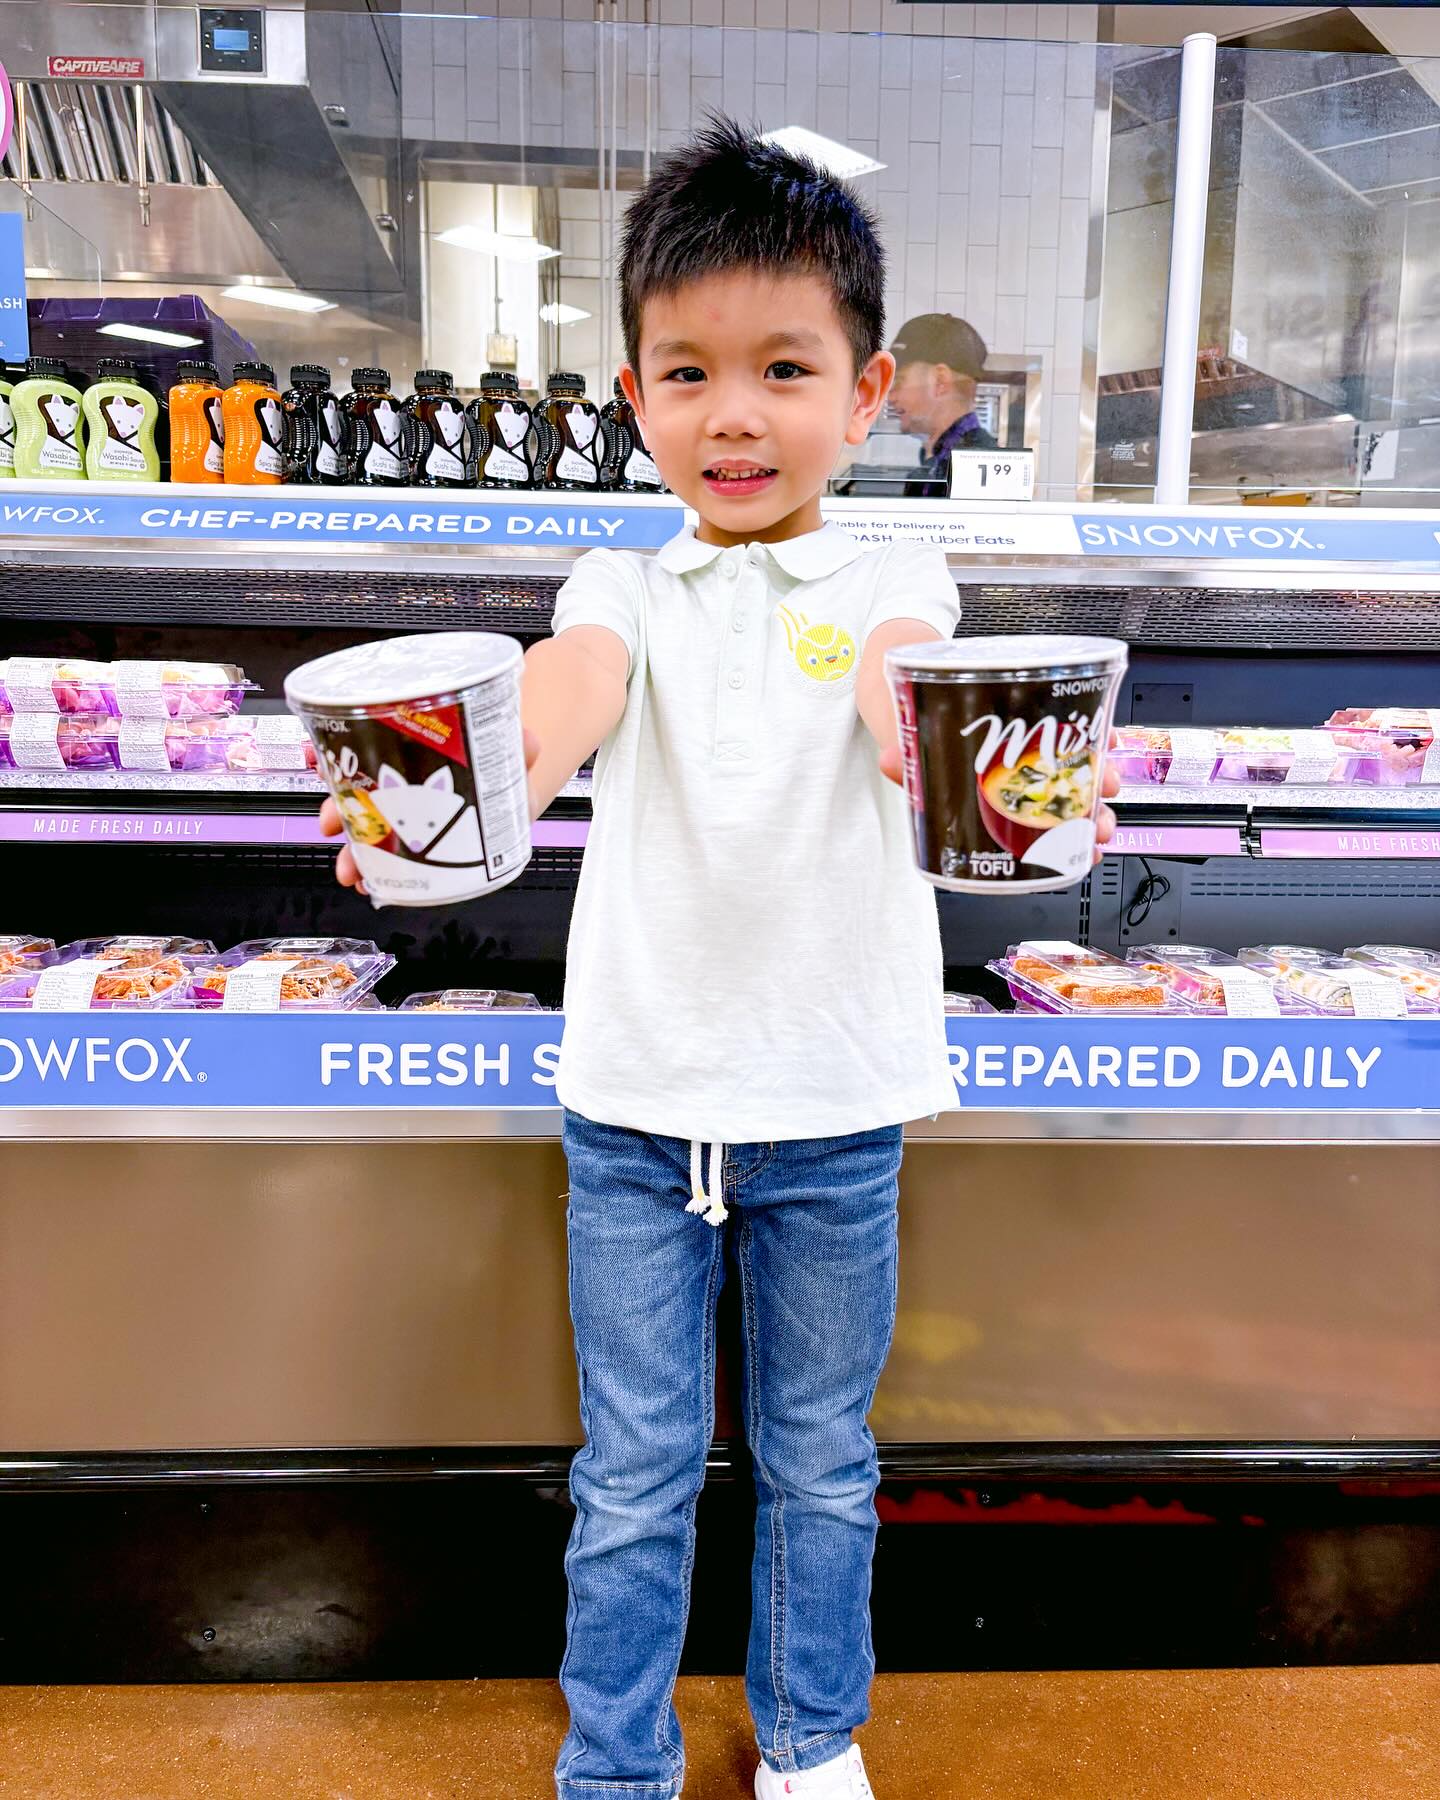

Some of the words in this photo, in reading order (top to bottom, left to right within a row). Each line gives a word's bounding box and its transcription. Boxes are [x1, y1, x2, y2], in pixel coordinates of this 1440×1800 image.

[42, 450, 69, 460] Wasabi
[103, 452, 130, 462] Wasabi
[492, 462, 508, 471] Sushi
[563, 463, 580, 473] Sushi
[140, 508, 492, 536] CHEF-PREPARED
[507, 516, 625, 538] DAILY
[871, 521, 889, 529] for
[893, 522, 945, 531] Delivery
[930, 535, 971, 545] Uber
[975, 536, 1016, 545] Eats
[33, 819, 79, 833] MADE
[90, 820, 145, 834] FRESH
[153, 821, 204, 835] DAILY
[1116, 832, 1165, 847] DAILY
[1338, 836, 1382, 851] MADE
[969, 860, 1015, 876] TOFU
[321, 1043, 510, 1086] FRESH
[1222, 1045, 1382, 1088] DAILY
